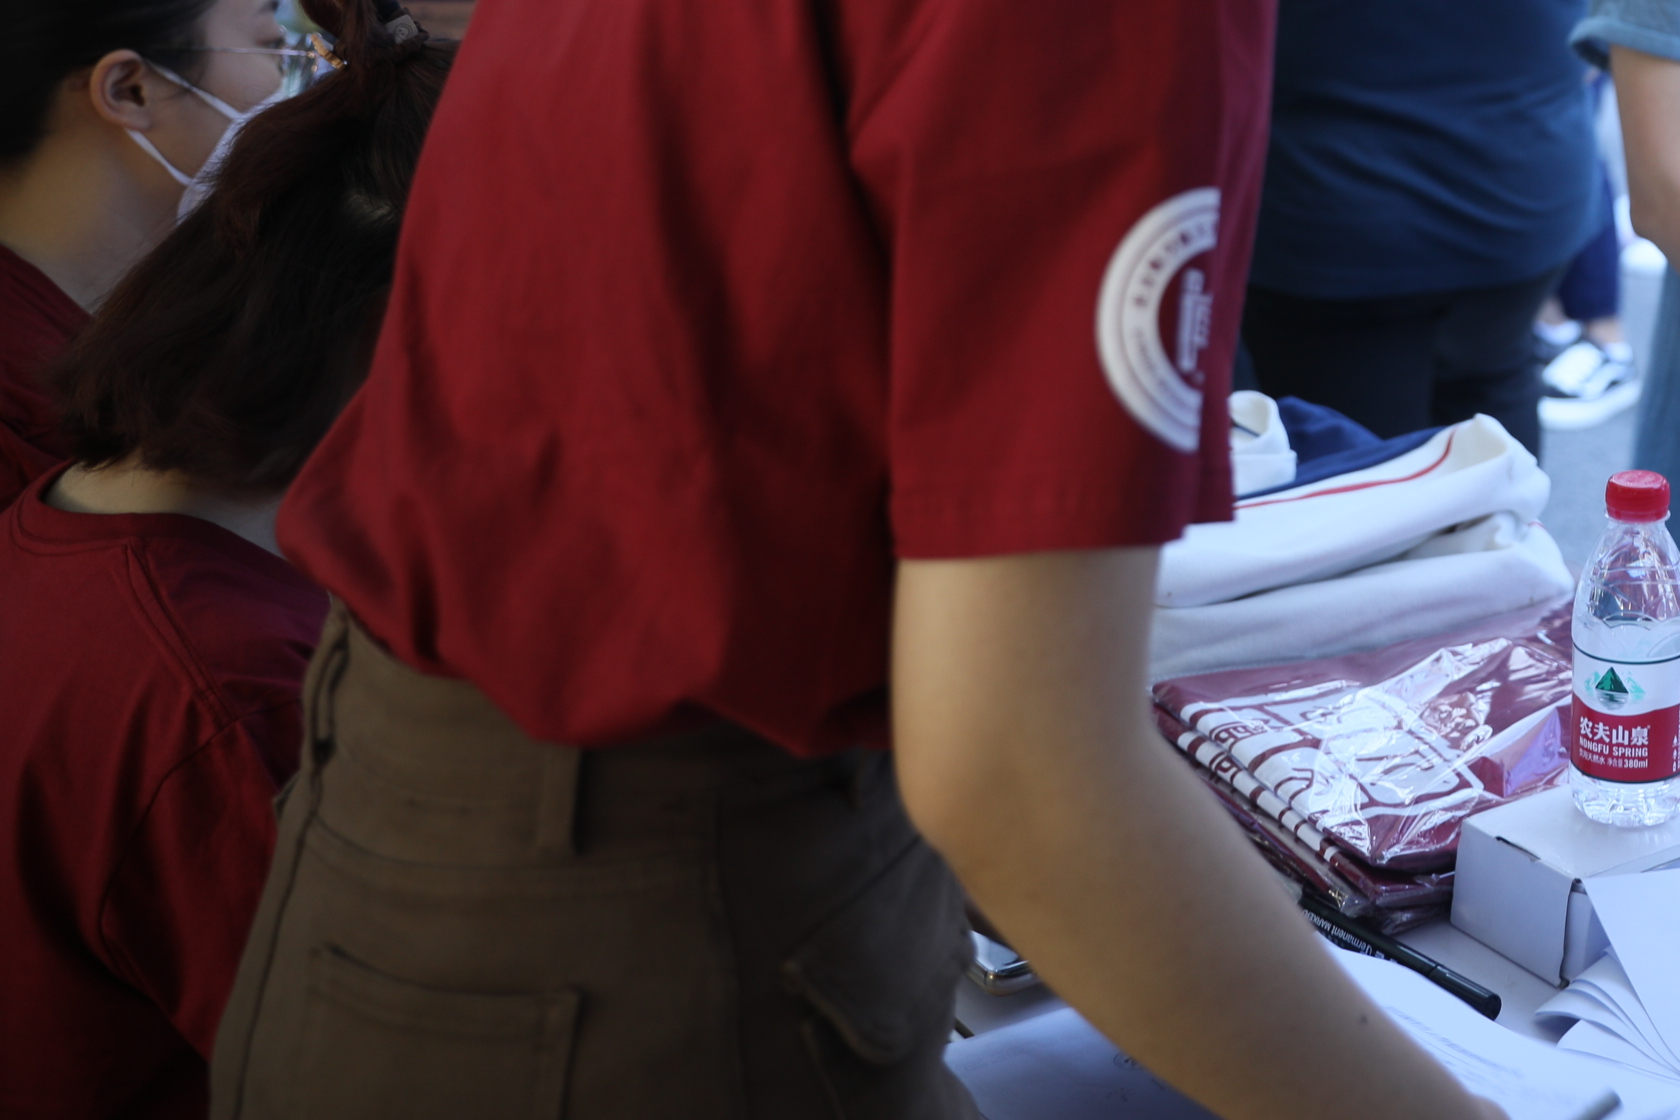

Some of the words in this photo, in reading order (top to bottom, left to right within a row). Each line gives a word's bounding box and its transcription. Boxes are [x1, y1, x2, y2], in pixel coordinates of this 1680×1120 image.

[1579, 716, 1649, 747] 农夫山泉
[1579, 735, 1610, 755] NONGFU
[1612, 746, 1649, 758] SPRING
